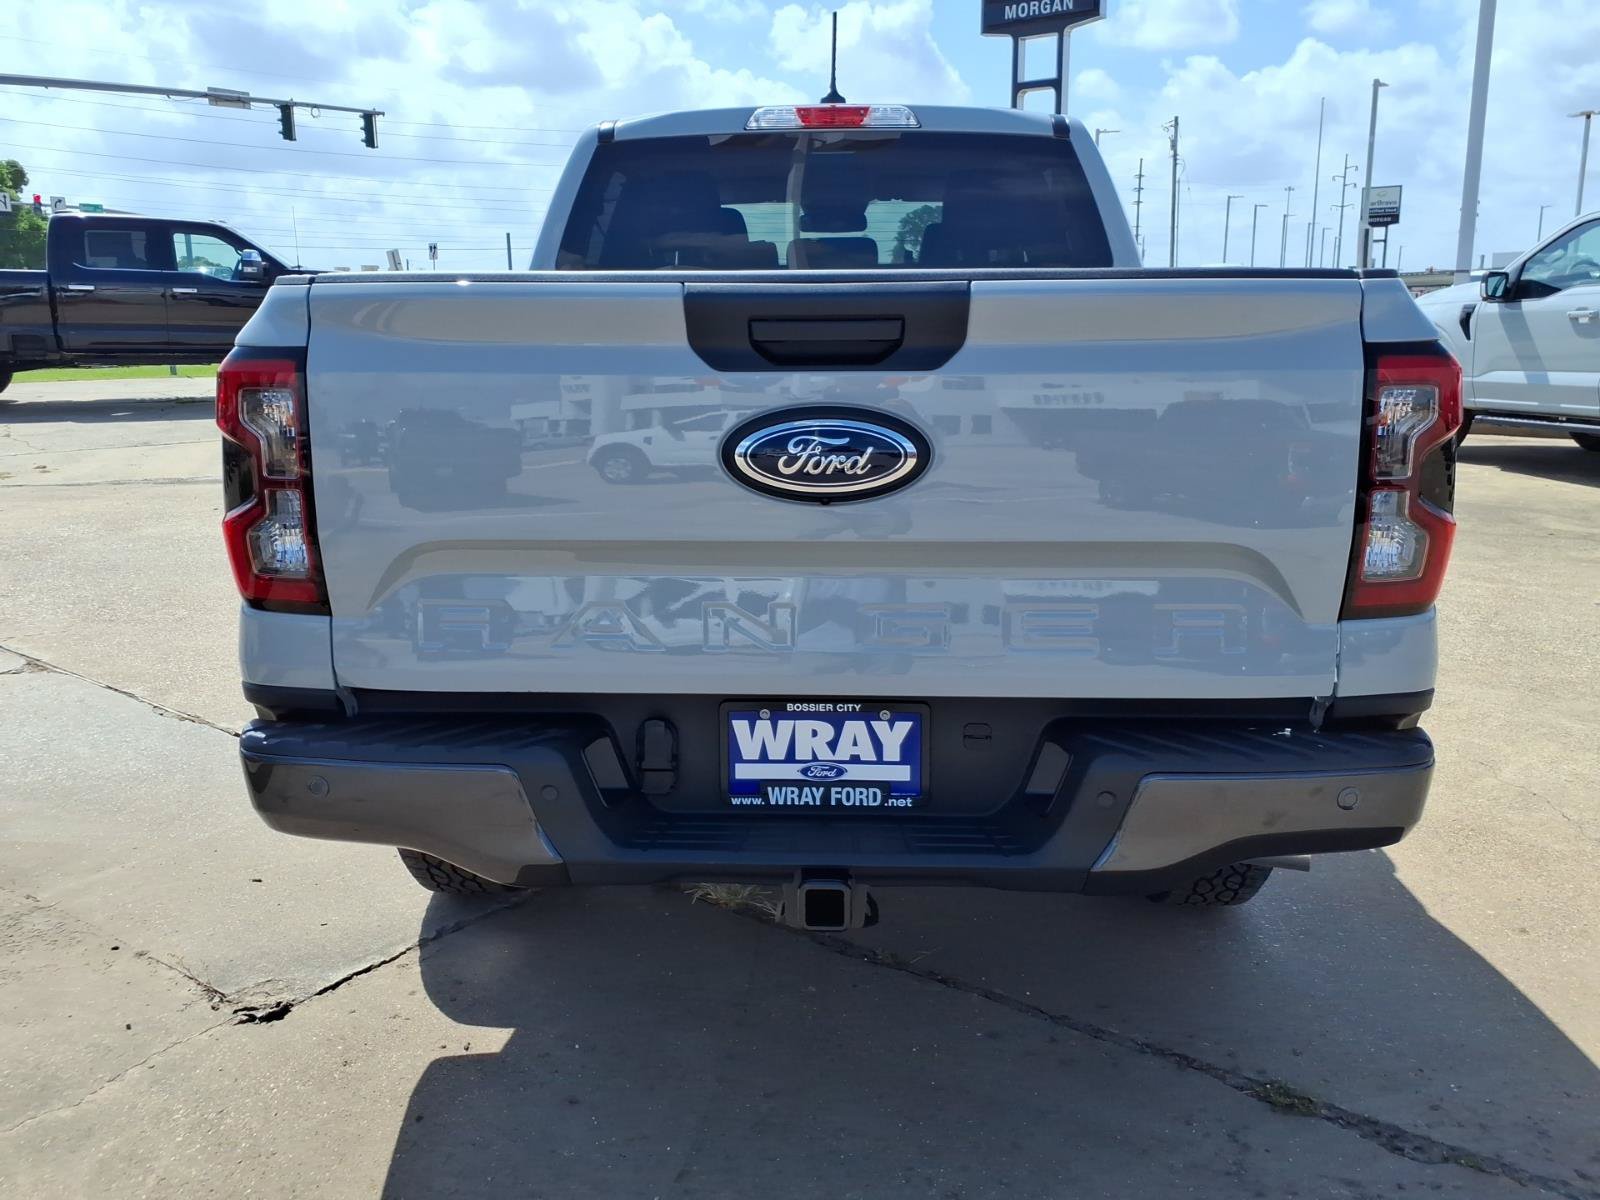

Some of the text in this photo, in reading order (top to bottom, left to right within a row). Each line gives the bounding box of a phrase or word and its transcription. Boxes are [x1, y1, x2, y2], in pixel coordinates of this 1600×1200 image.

[1004, 0, 1074, 20] MORGAN
[778, 435, 874, 475] Ford
[417, 599, 1247, 655] RANGER
[786, 703, 861, 712] BOSSIER CITY
[731, 719, 913, 762] WRAY
[807, 766, 837, 778] Ford
[767, 786, 824, 806] WRAY
[830, 787, 882, 806] FORD
[884, 797, 912, 807] .net
